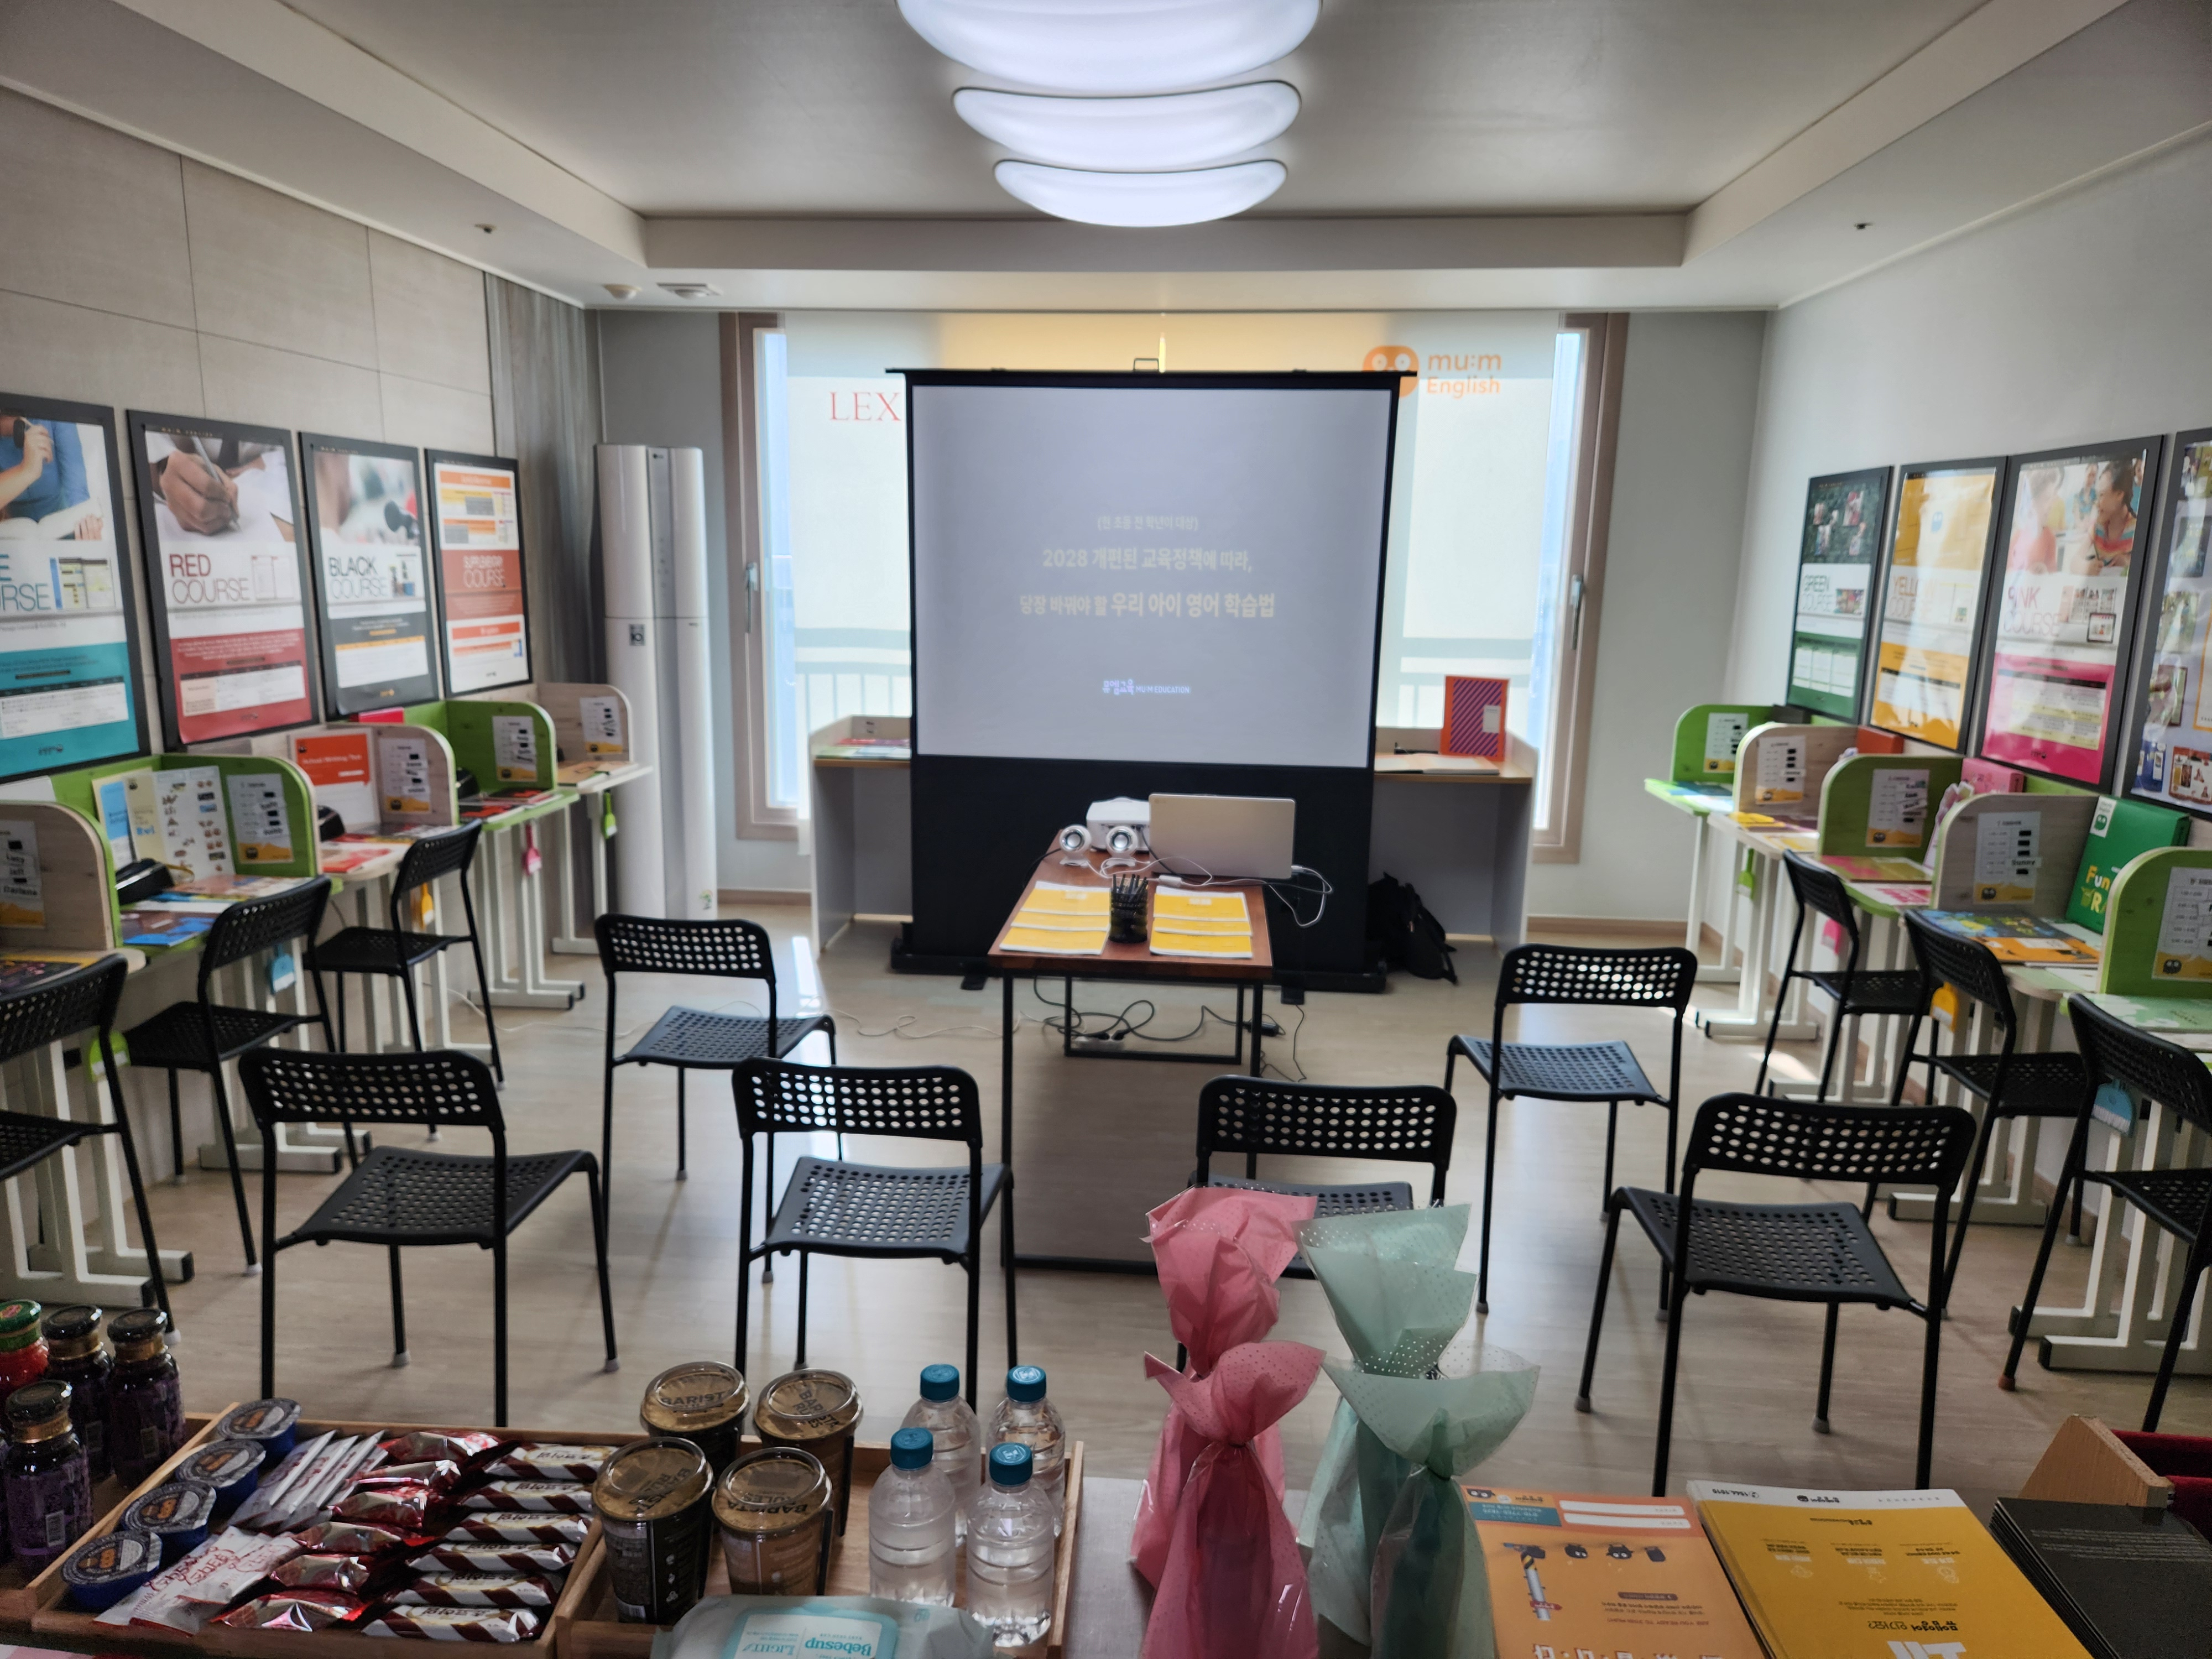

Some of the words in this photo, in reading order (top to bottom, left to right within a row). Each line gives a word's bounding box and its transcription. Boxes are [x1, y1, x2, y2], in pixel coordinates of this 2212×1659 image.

[1426, 374, 1500, 398] English
[830, 392, 901, 423] LEX
[169, 553, 211, 577] RED
[328, 556, 379, 577] BLACK
[1042, 549, 1088, 567] 2028
[1092, 547, 1137, 570] 개편된
[1141, 547, 1217, 571] 교육정책에
[172, 577, 251, 604] COURSE
[331, 577, 388, 599] COURSE
[1803, 575, 1831, 592] GREEN
[0, 583, 51, 611] RSE
[1020, 595, 1046, 615] 당장
[1051, 596, 1090, 615] 바꿔야
[1094, 596, 1107, 616] 할
[1112, 592, 1143, 617] 우리
[1148, 593, 1181, 617] 아이
[1186, 593, 1218, 618] 영어
[1224, 593, 1275, 618] 학습법
[2004, 611, 2062, 637] COURSE
[1154, 686, 1190, 694] EDUCATION
[2086, 864, 2111, 891] Fun
[793, 1402, 823, 1428] RUES
[1911, 1621, 1958, 1631] 뮤엠영어
[805, 1637, 873, 1657] Bebesup
